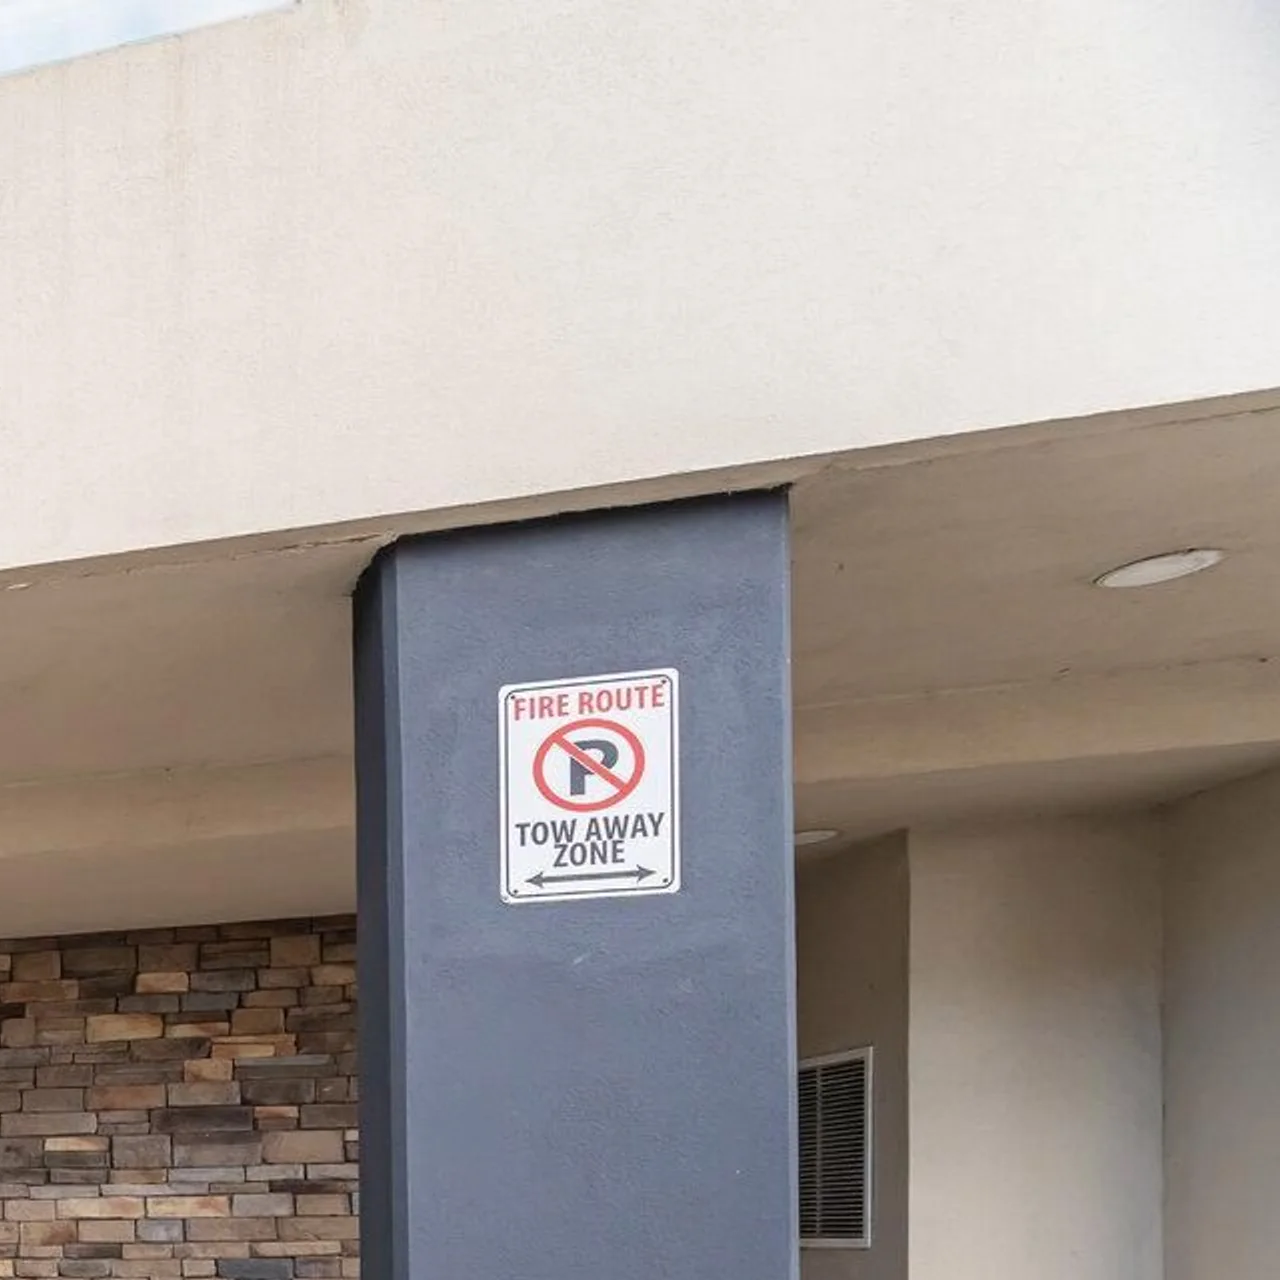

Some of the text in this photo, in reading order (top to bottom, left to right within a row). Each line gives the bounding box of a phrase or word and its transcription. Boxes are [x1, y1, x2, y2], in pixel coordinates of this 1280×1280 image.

[513, 684, 666, 721] FIRE ROUTE
[569, 739, 619, 796] P
[515, 812, 665, 847] TOW AWAY
[553, 840, 625, 867] ZONE
